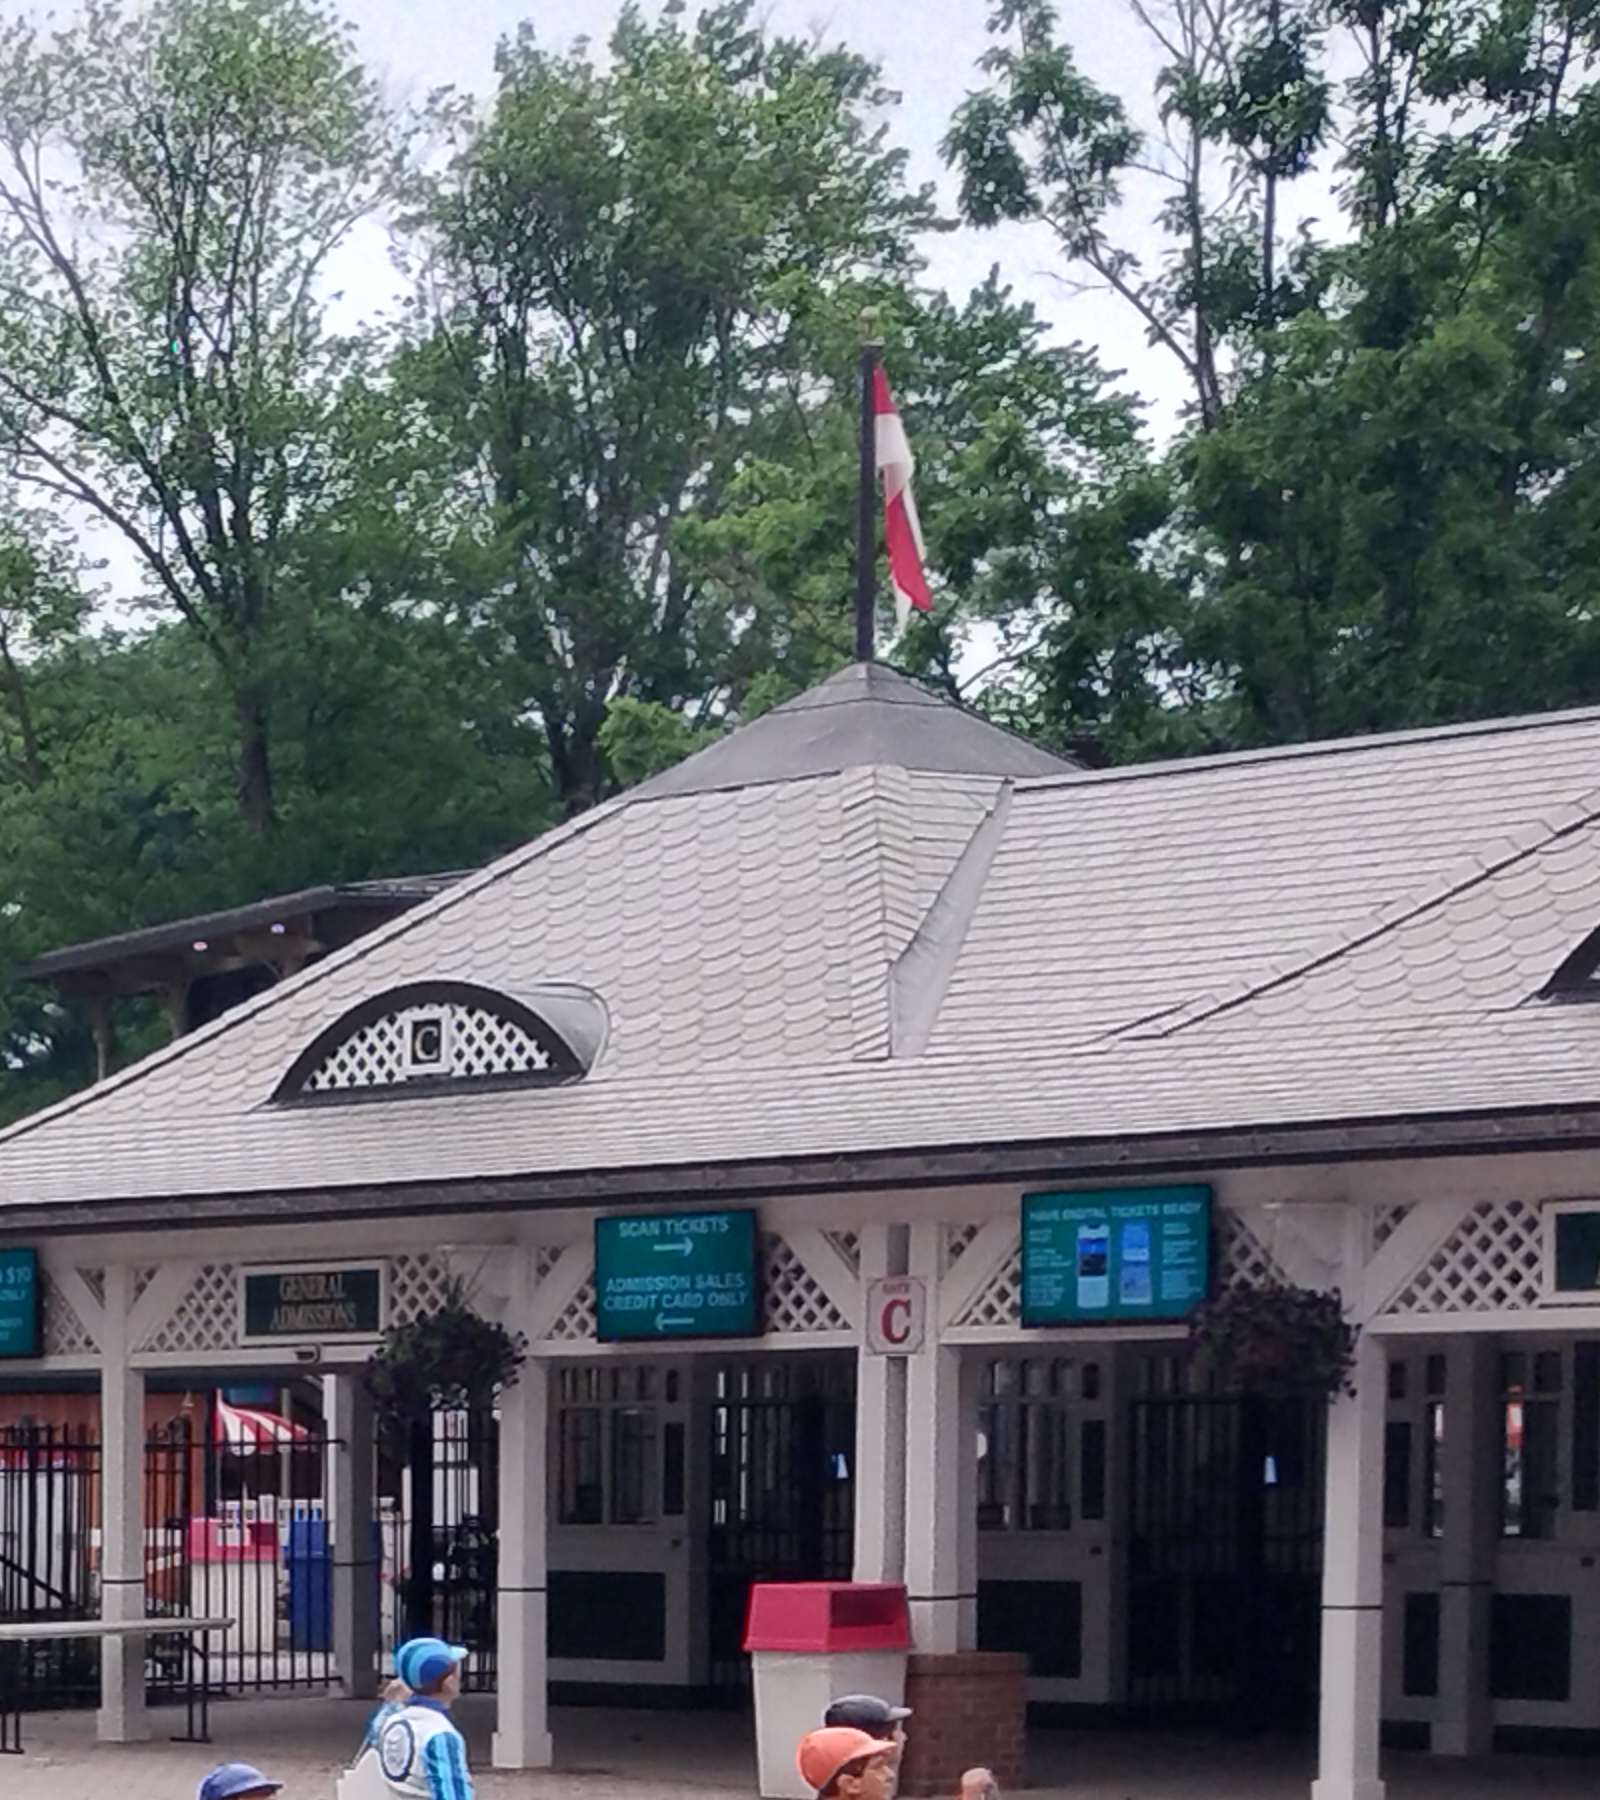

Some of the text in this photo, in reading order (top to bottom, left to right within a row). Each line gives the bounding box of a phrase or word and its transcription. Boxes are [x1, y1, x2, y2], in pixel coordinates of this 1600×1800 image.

[413, 1026, 439, 1061] C
[618, 1215, 730, 1238] SCAN TICKETS
[279, 1273, 347, 1301] GENERAL
[605, 1272, 746, 1293] ADMISSION SALES
[603, 1289, 748, 1312] CREDIT CARD ONLY
[270, 1301, 357, 1331] ADMISSIONS
[881, 1299, 911, 1345] C
